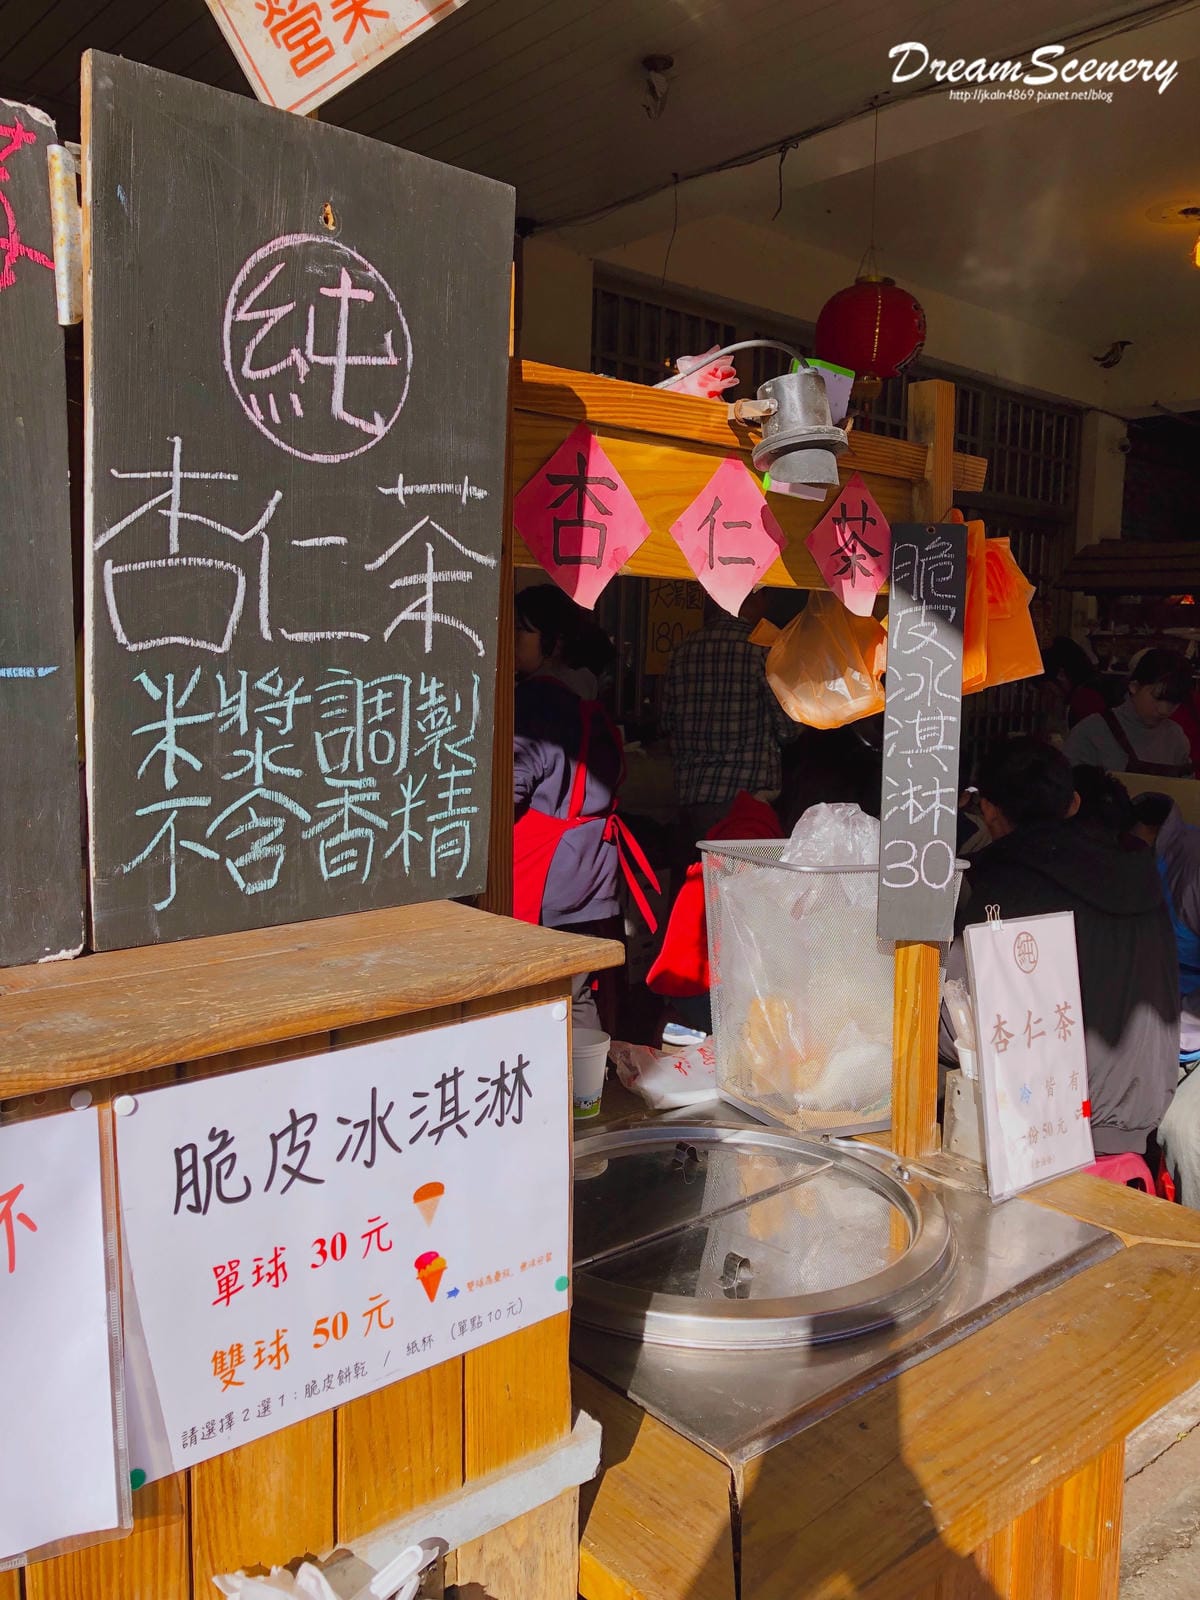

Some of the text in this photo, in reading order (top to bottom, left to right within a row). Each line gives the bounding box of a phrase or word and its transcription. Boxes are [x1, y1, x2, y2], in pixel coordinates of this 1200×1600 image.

[94, 436, 497, 657] 杏仁茶
[546, 452, 884, 588] 杏仁茶
[132, 667, 478, 790] 米漿調製
[882, 536, 961, 890] 脆皮冰淇淋 30
[120, 770, 480, 911] 不含香精
[990, 1001, 1076, 1053] 杏仁茶
[173, 1053, 532, 1216] 脆皮冰淇淋
[212, 1216, 393, 1307] 單球 30 元
[211, 1293, 394, 1392] 雙球 50 元
